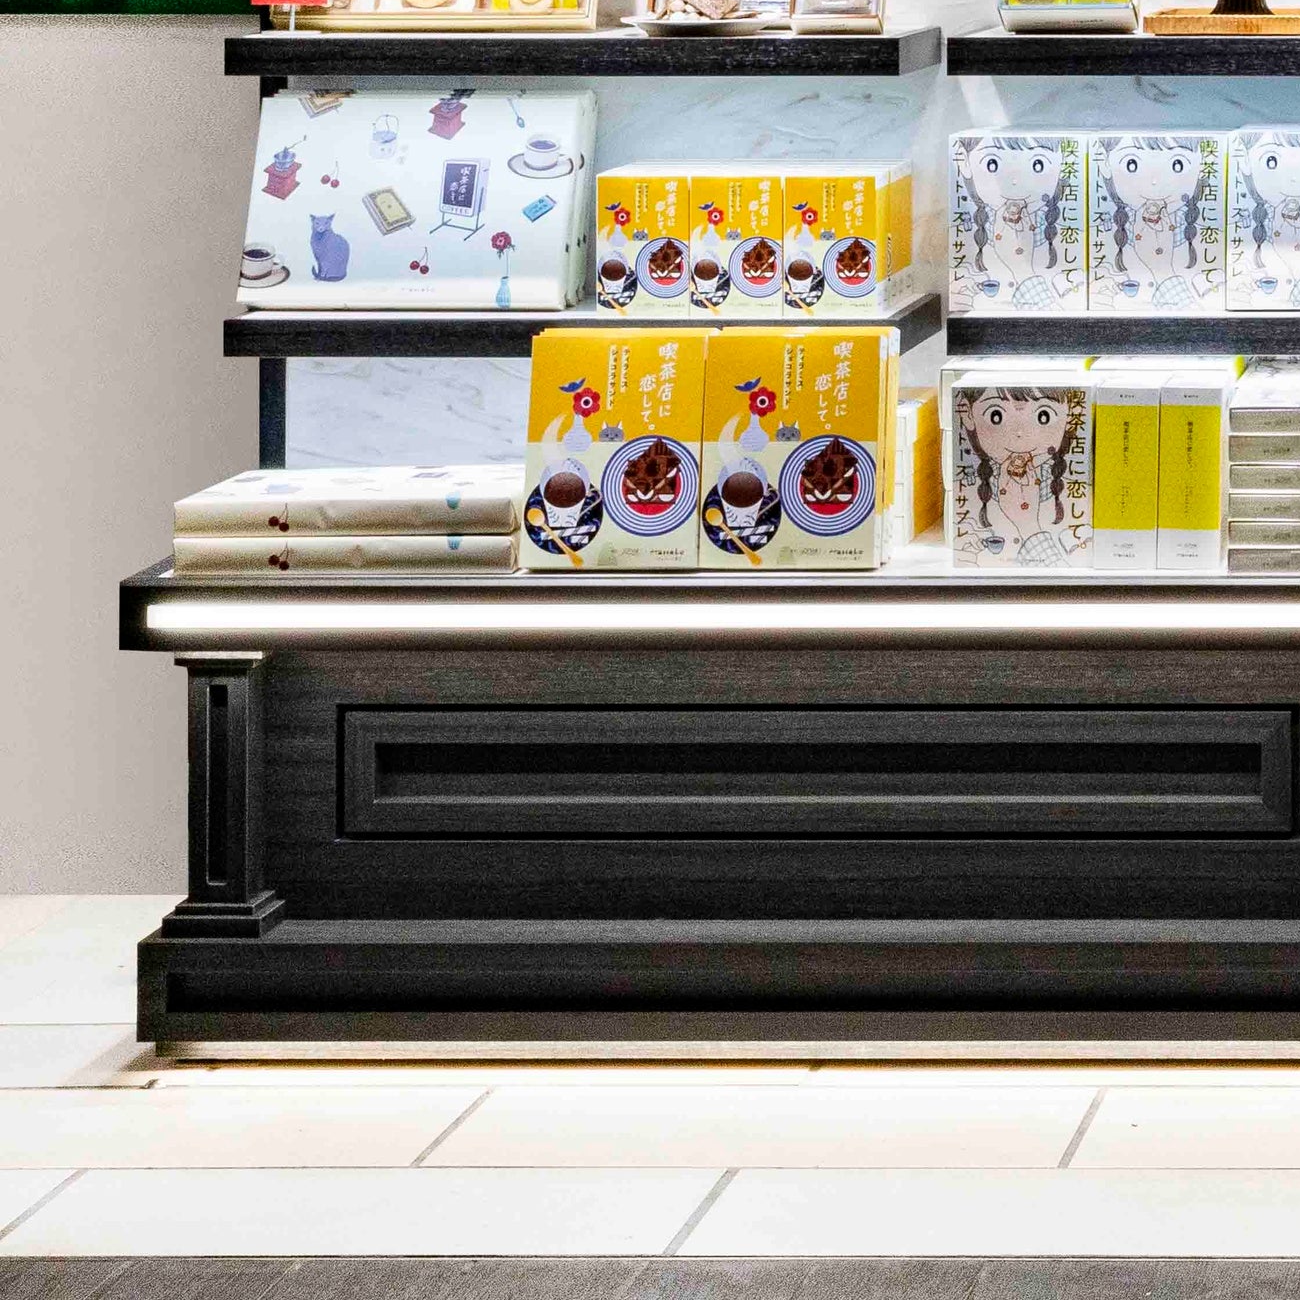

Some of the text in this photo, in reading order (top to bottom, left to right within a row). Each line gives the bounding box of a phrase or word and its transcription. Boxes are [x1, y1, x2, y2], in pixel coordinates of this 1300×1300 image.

[638, 373, 657, 432] 恋して。
[657, 341, 679, 418] 喫茶店に
[814, 373, 833, 432] 恋して。
[832, 341, 855, 418] 喫茶店に
